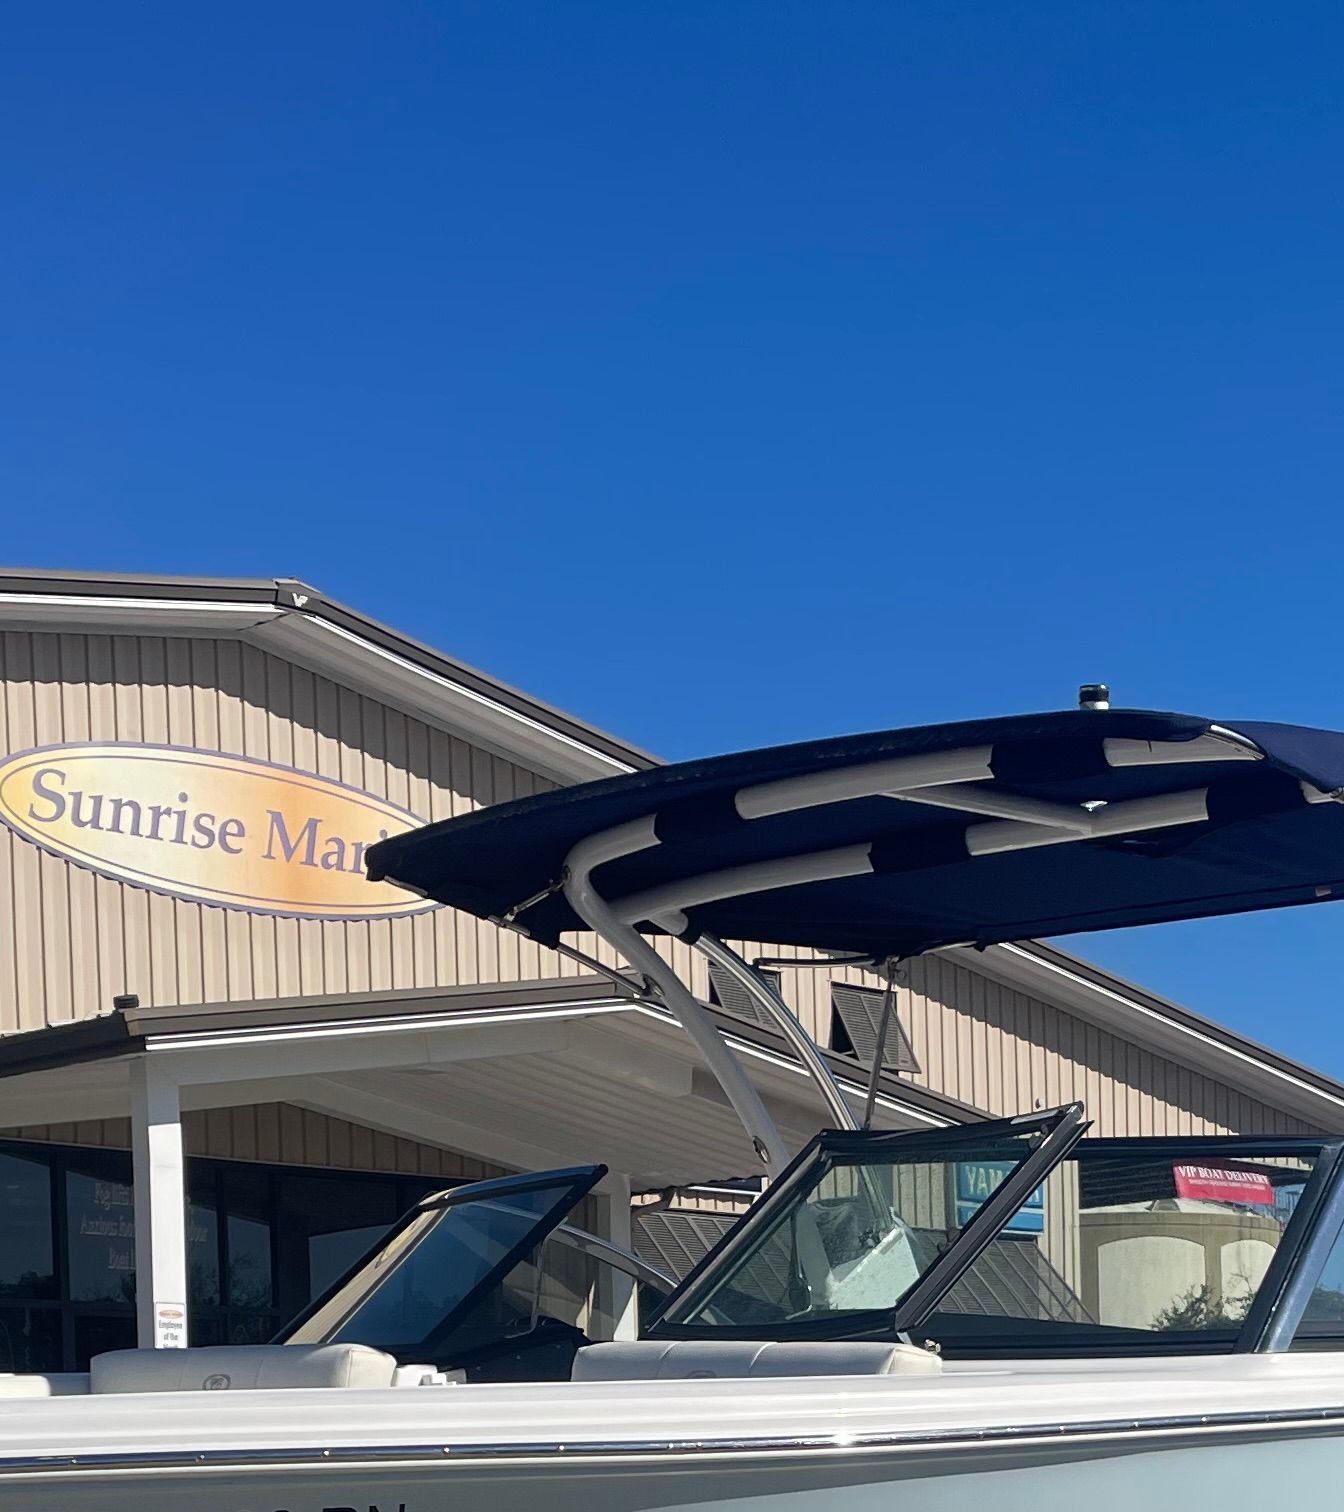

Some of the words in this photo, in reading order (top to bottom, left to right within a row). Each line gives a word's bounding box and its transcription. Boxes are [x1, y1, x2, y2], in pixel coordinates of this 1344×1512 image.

[27, 767, 246, 854] Sunrise
[261, 809, 388, 876] Mar
[1178, 1165, 1196, 1178] VIP
[1196, 1167, 1223, 1180] BOAT
[1223, 1170, 1270, 1185] DELIVERY
